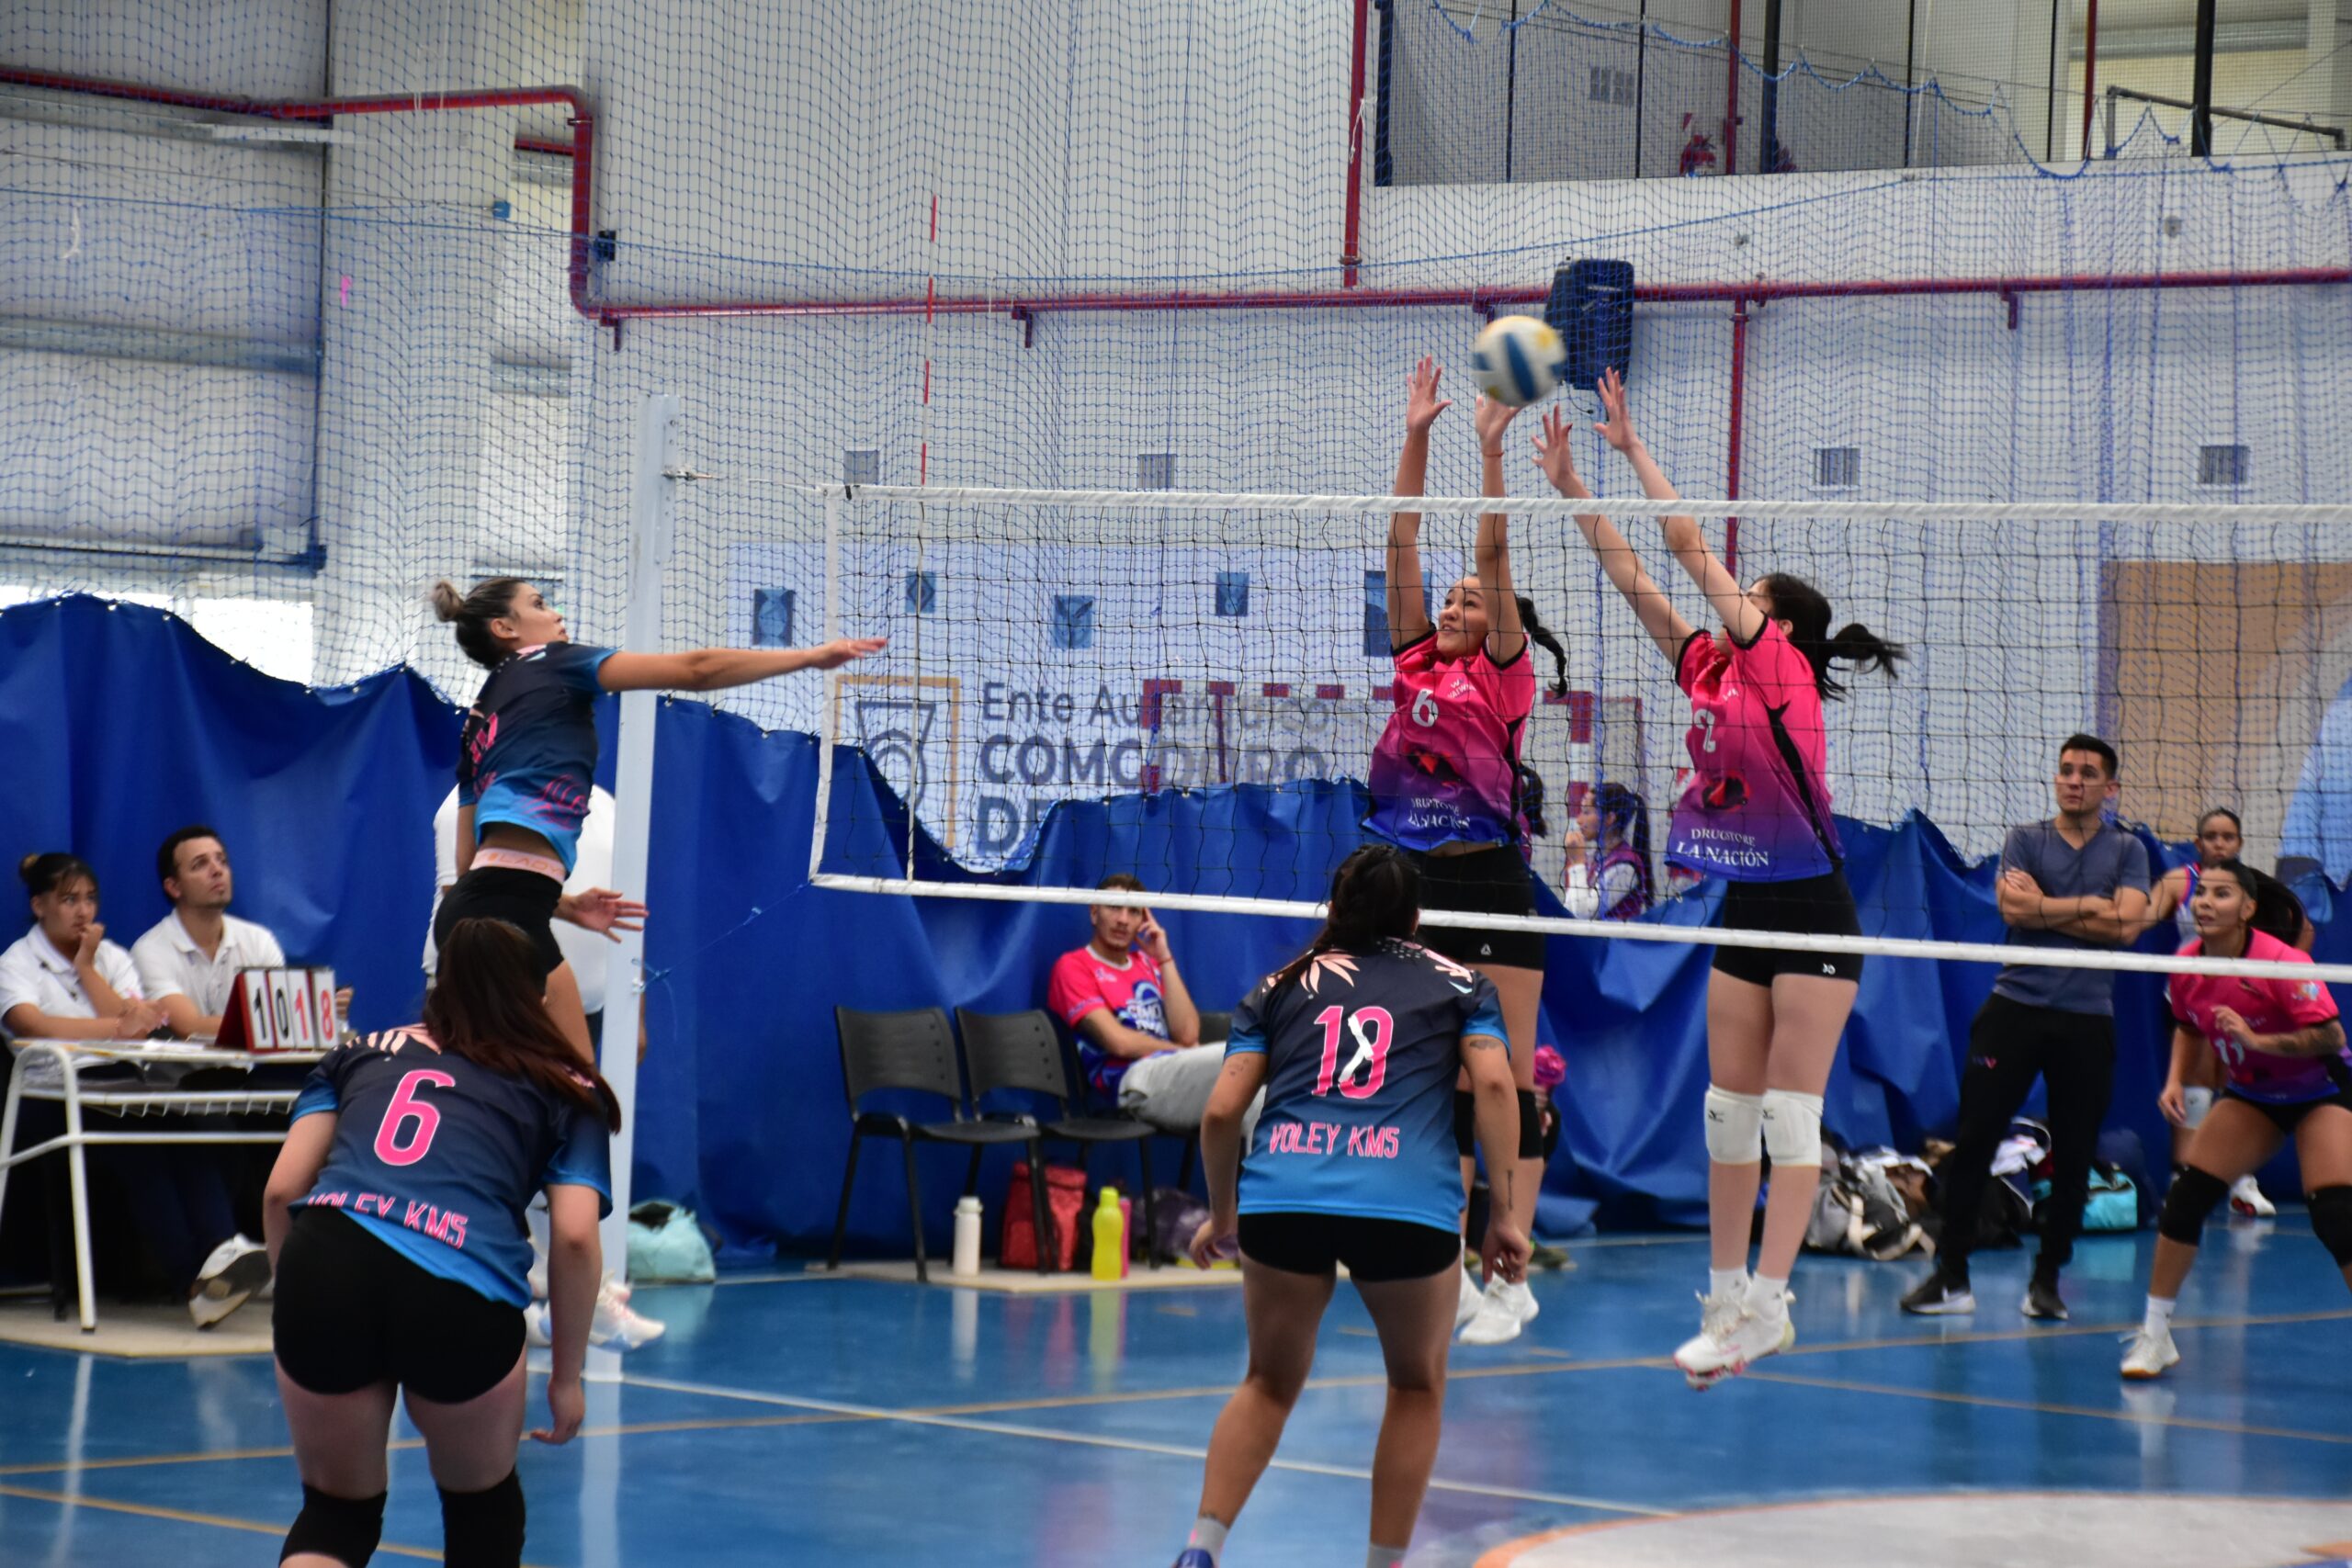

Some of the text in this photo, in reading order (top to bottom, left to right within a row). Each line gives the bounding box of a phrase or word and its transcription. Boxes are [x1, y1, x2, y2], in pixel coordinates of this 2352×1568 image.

[983, 682, 1073, 724] Ente
[1411, 688, 1439, 728] 6
[1693, 708, 1716, 752] 2
[1677, 841, 1770, 867] LA NACIÓN
[1311, 1005, 1394, 1099] 18
[374, 1068, 456, 1167] 6
[1269, 1122, 1341, 1155] VOLEY
